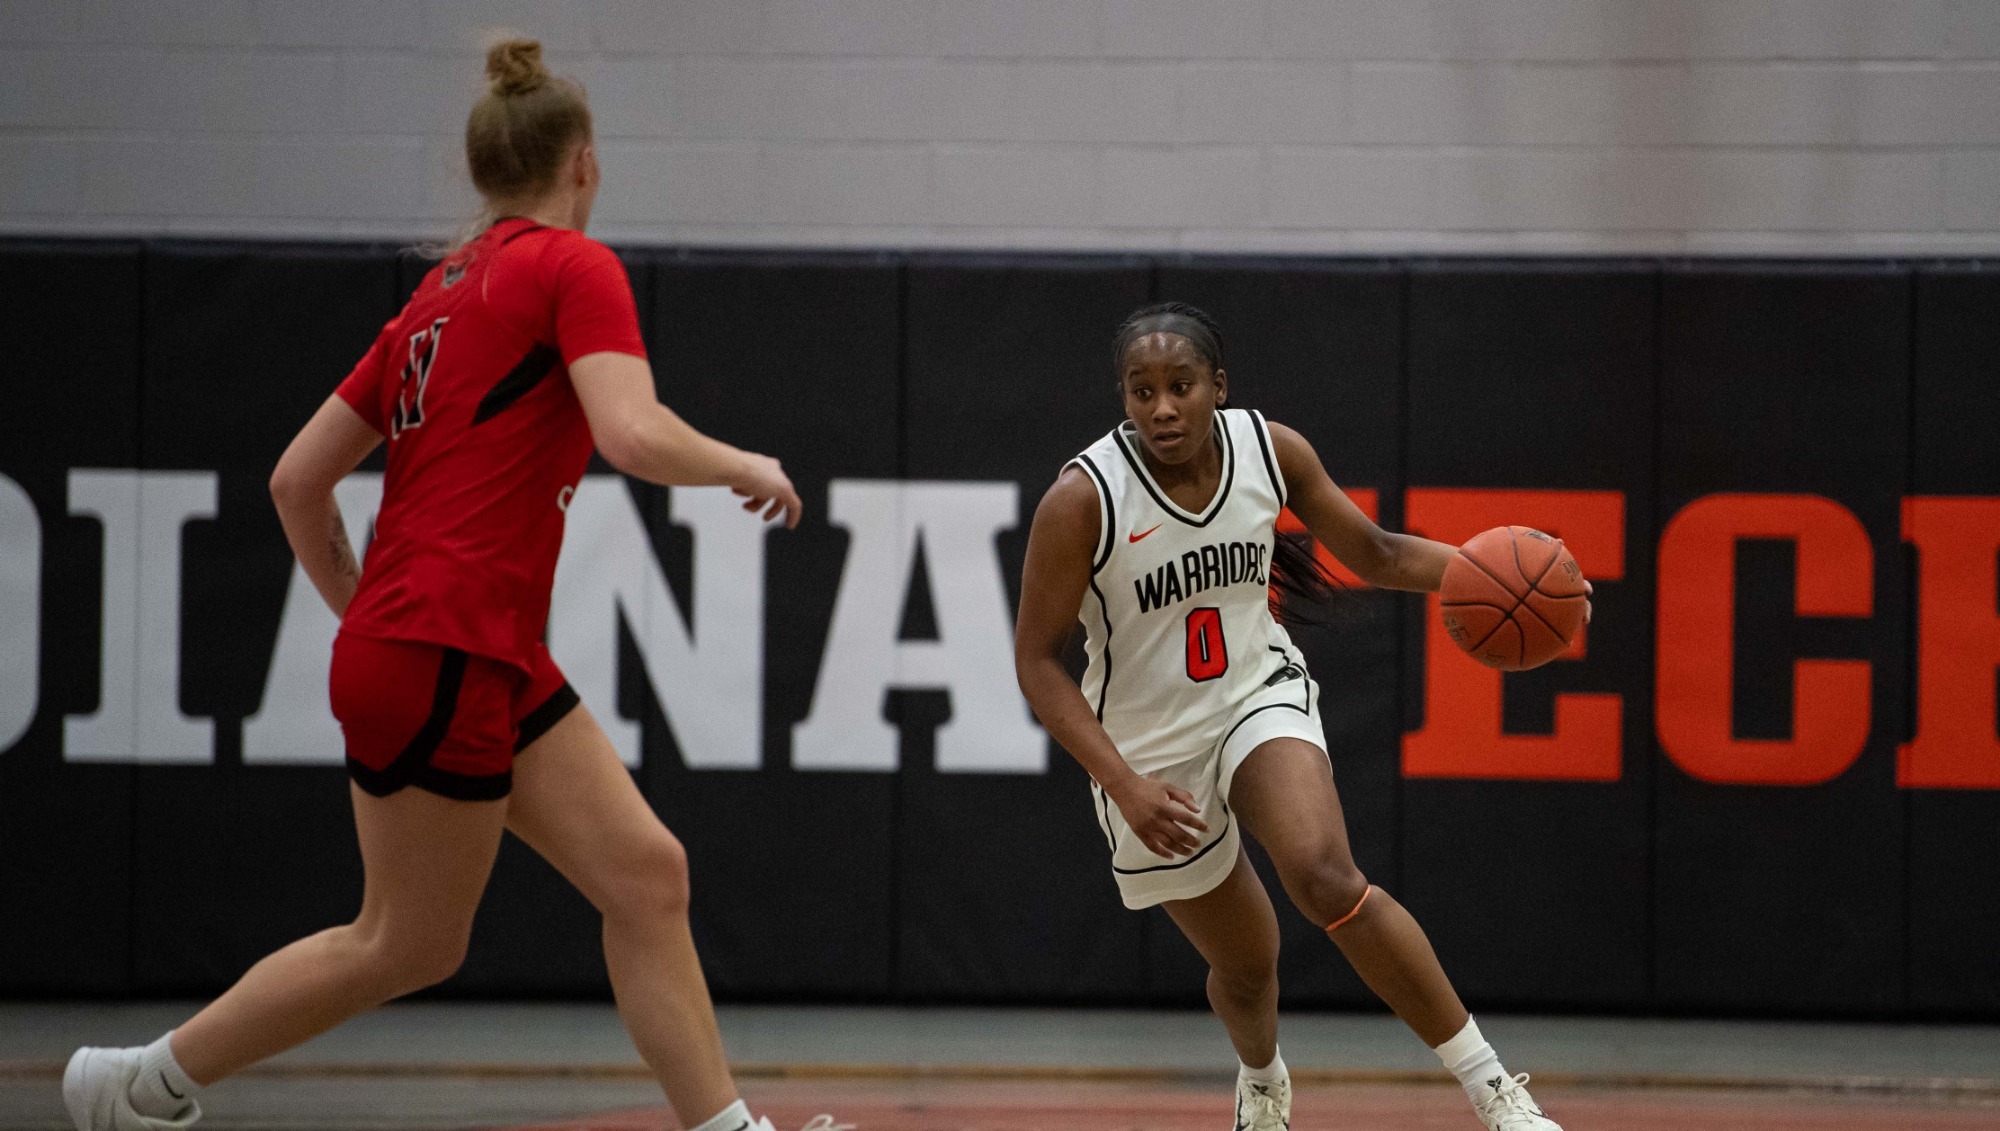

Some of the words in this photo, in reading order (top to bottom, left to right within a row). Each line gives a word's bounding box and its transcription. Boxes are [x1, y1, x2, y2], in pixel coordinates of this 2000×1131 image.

[1134, 542, 1267, 614] WARRIORS
[0, 469, 1048, 774] INA
[1275, 488, 2000, 789] EC
[1185, 607, 1229, 683] 0
